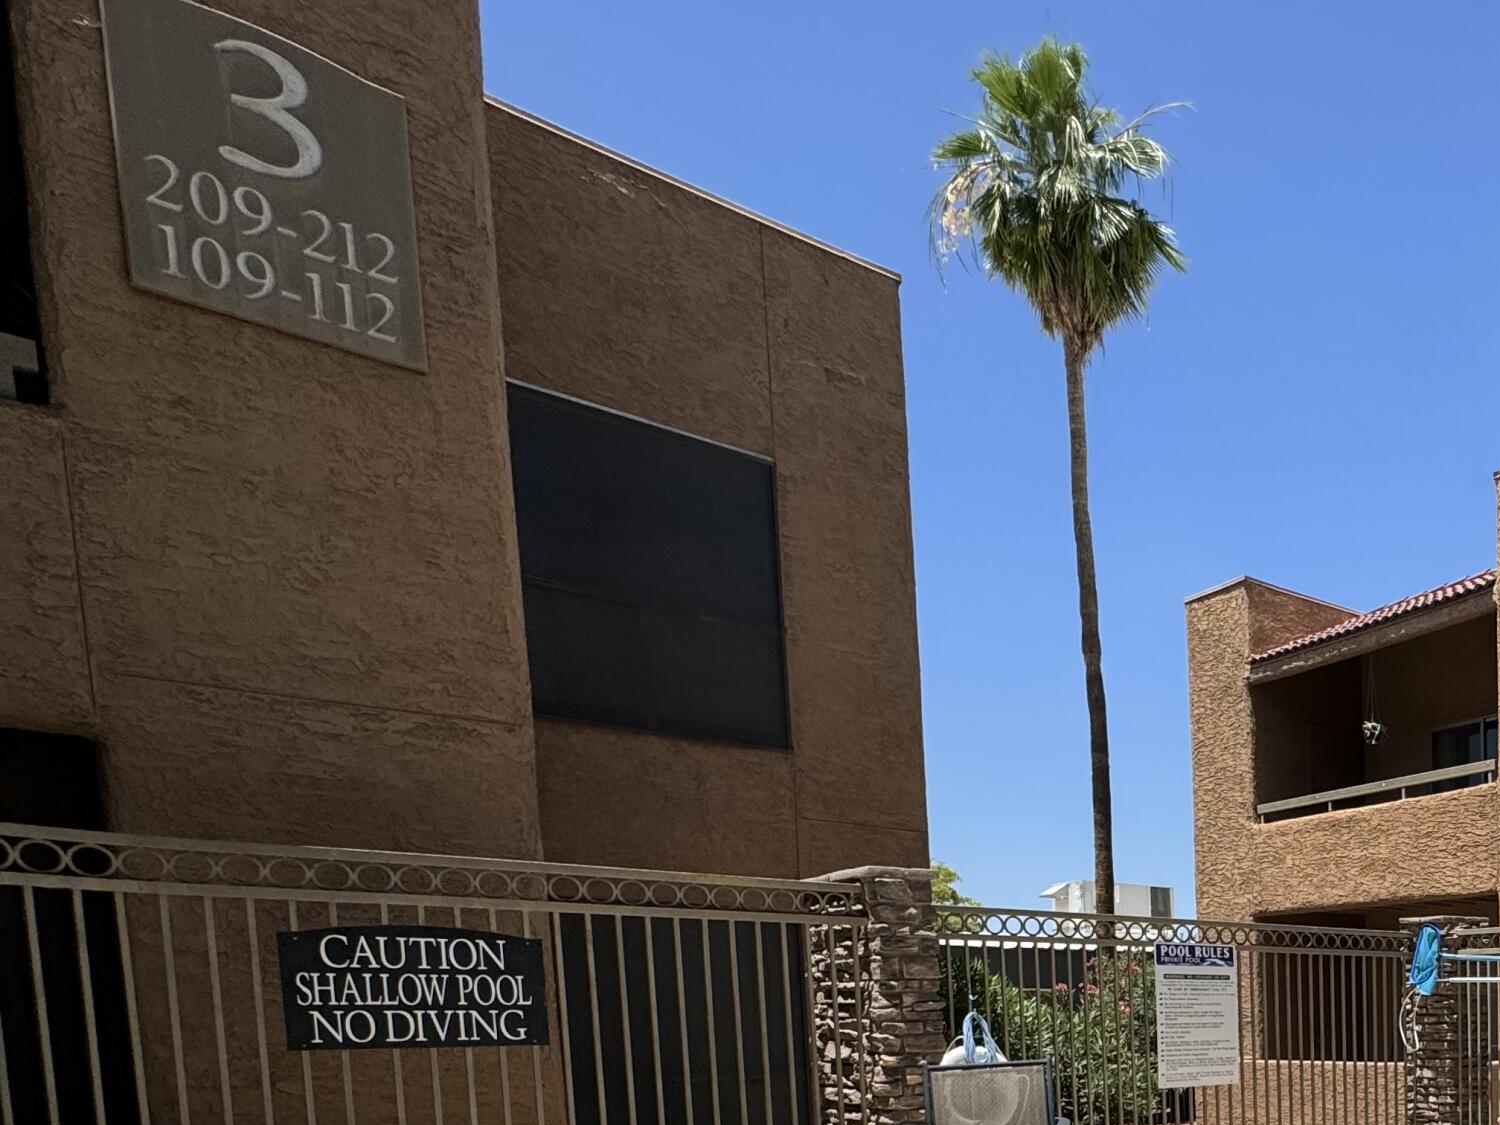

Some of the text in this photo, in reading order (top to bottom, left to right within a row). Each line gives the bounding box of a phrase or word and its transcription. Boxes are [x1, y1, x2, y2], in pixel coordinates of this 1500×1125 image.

[213, 38, 323, 179] 3
[143, 153, 400, 284] 209-212
[157, 223, 398, 344] 109-112
[319, 934, 507, 971] CAUTION
[1160, 945, 1230, 959] POOL RULES
[295, 971, 533, 1006] SHALLOW POOL
[308, 1009, 529, 1044] NO DIVING
